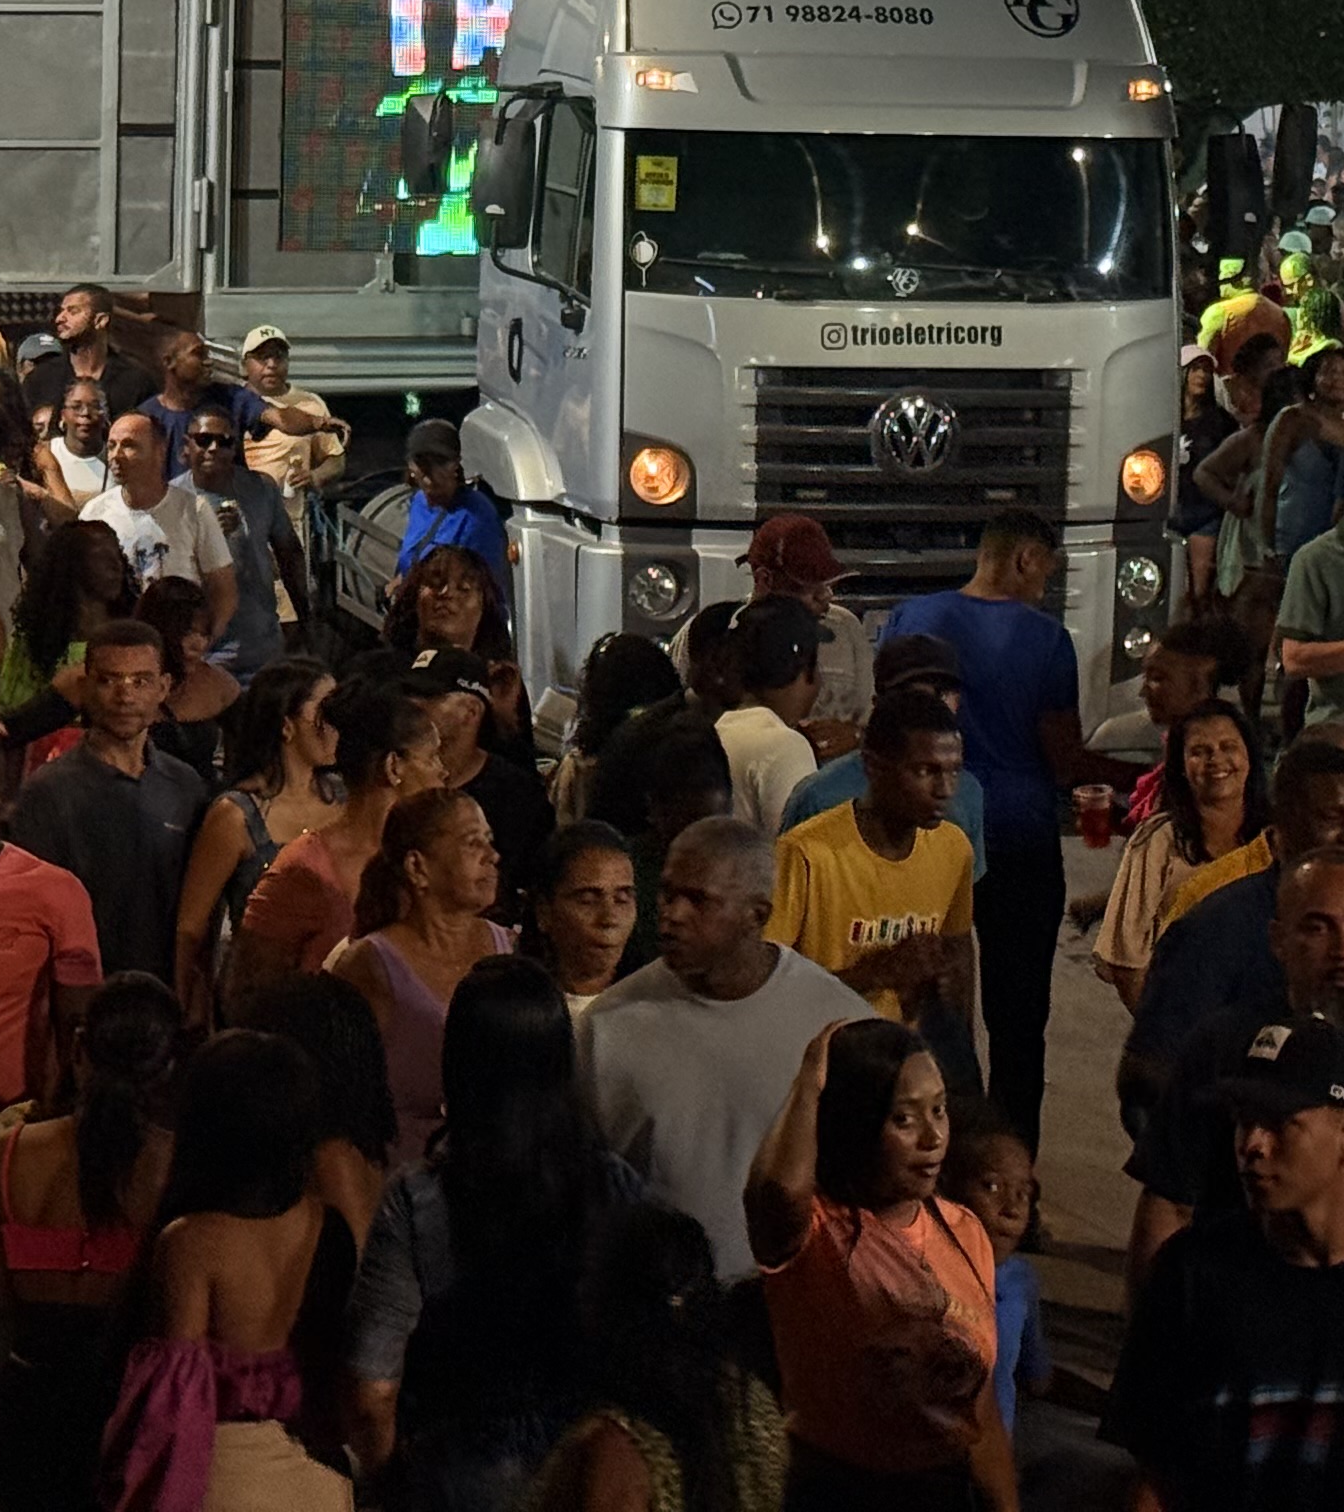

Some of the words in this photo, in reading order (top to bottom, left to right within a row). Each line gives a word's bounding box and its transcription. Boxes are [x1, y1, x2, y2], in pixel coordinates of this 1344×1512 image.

[746, 5, 775, 23] 71
[785, 4, 934, 26] 98824-8080
[852, 321, 1004, 347] trioeletricorg
